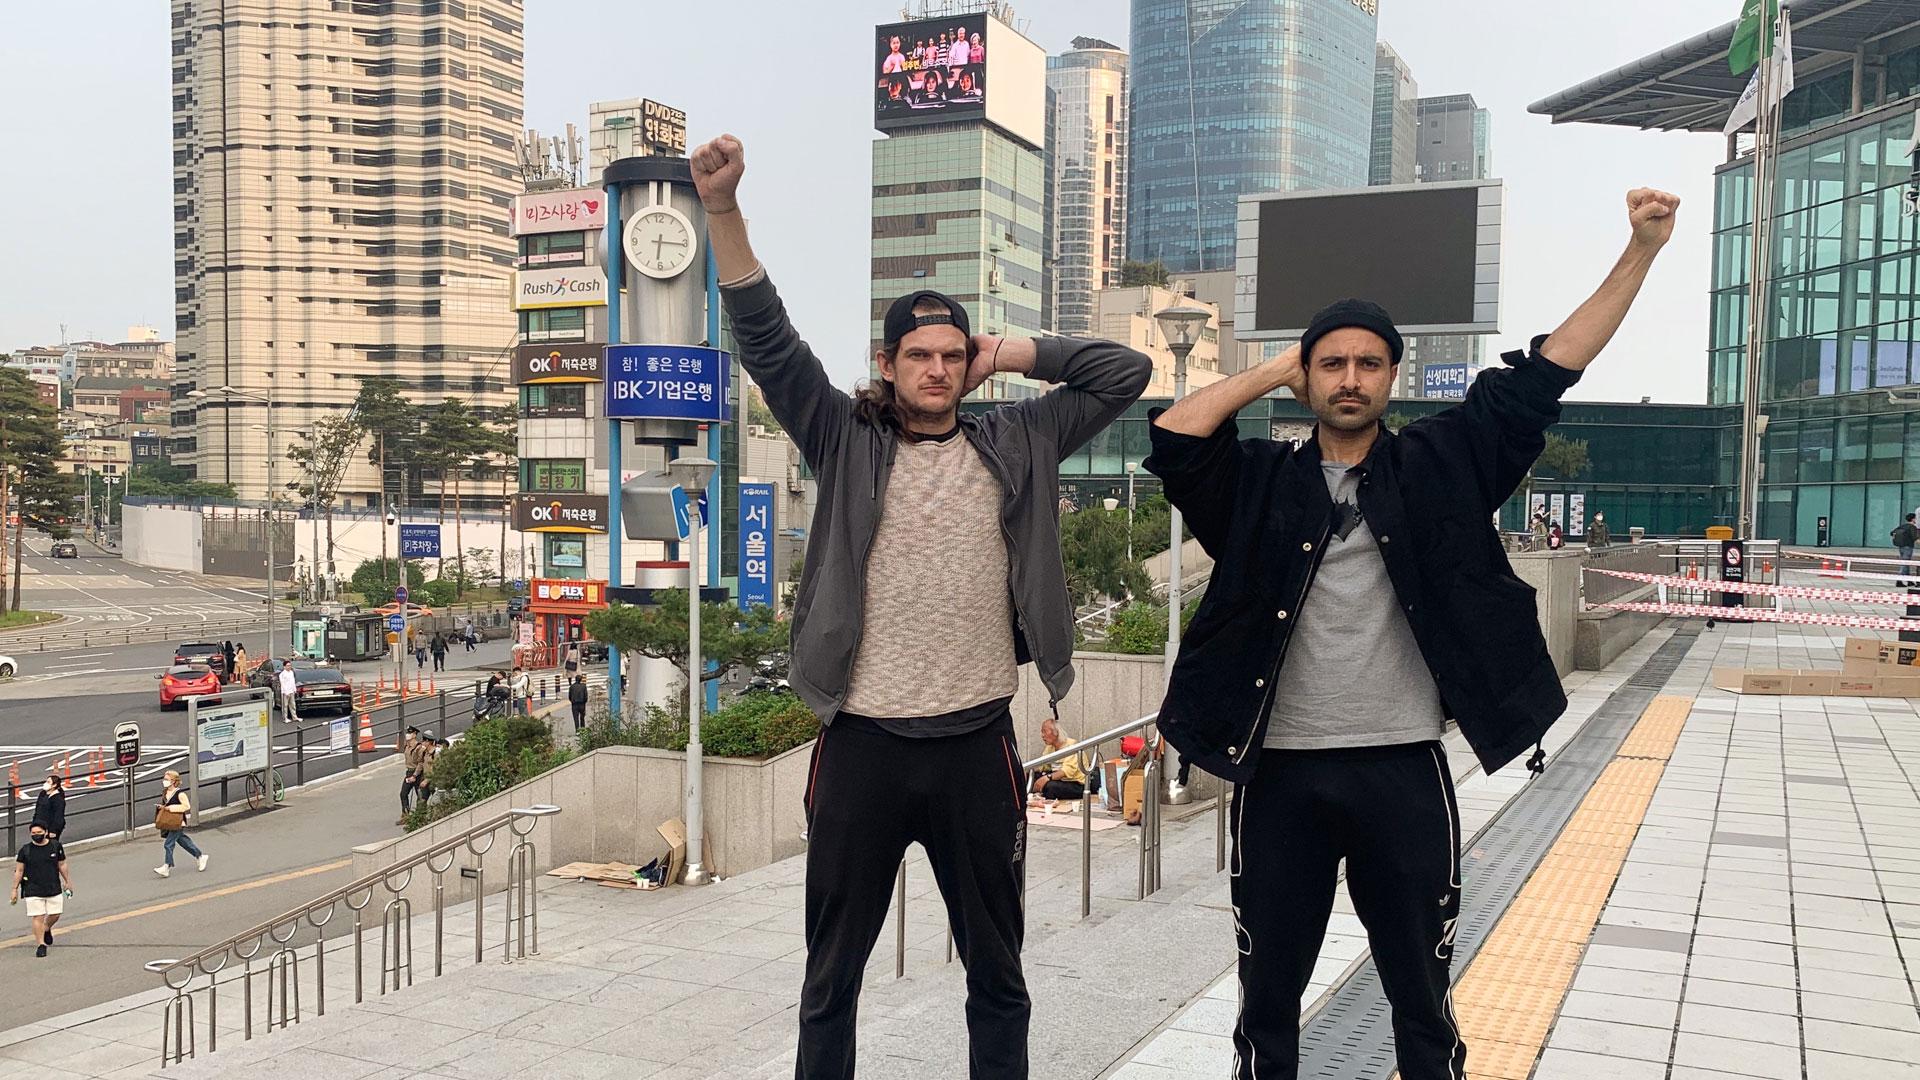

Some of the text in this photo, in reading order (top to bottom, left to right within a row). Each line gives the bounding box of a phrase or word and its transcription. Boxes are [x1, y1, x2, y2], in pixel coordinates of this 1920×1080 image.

[645, 101, 670, 121] DVD
[645, 118, 685, 151] 영화관
[526, 202, 579, 223] 미즈사랑
[655, 214, 665, 223] 12
[631, 237, 638, 247] 9
[657, 262, 664, 271] 6
[523, 278, 600, 295] Rush Cash
[561, 357, 597, 371] 저축은행
[622, 356, 702, 374] 참! 좋은 은행
[1426, 367, 1465, 386] 신성대학교
[613, 380, 644, 400] IBK
[646, 380, 712, 402] 기업은행
[562, 508, 597, 521] 저축은행
[412, 540, 432, 553] 주차장
[745, 505, 767, 584] 서울역
[1012, 820, 1024, 863] BOSS
